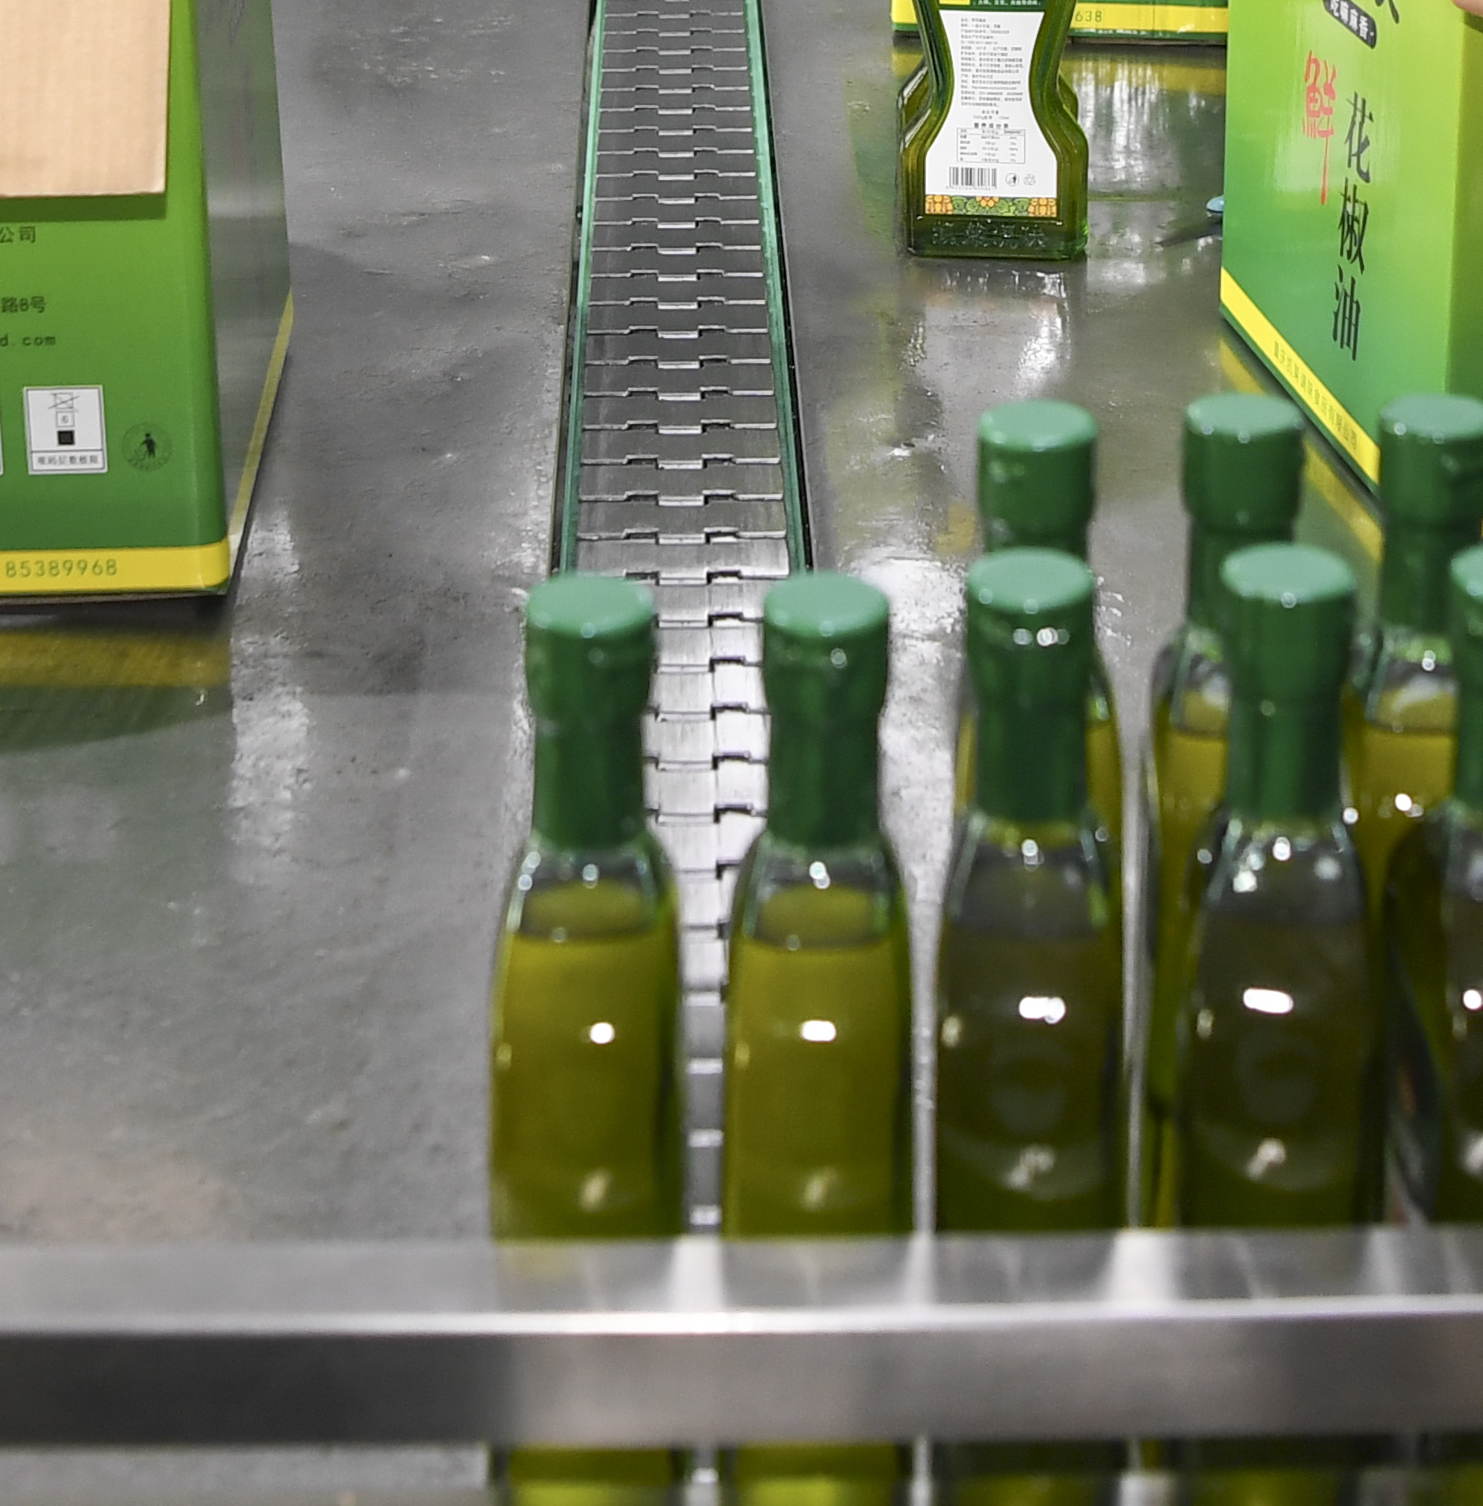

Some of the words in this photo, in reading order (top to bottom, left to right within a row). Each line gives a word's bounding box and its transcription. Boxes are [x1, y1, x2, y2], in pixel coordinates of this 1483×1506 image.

[1332, 91, 1376, 361] 花椒油
[5, 559, 118, 579] 85389968
